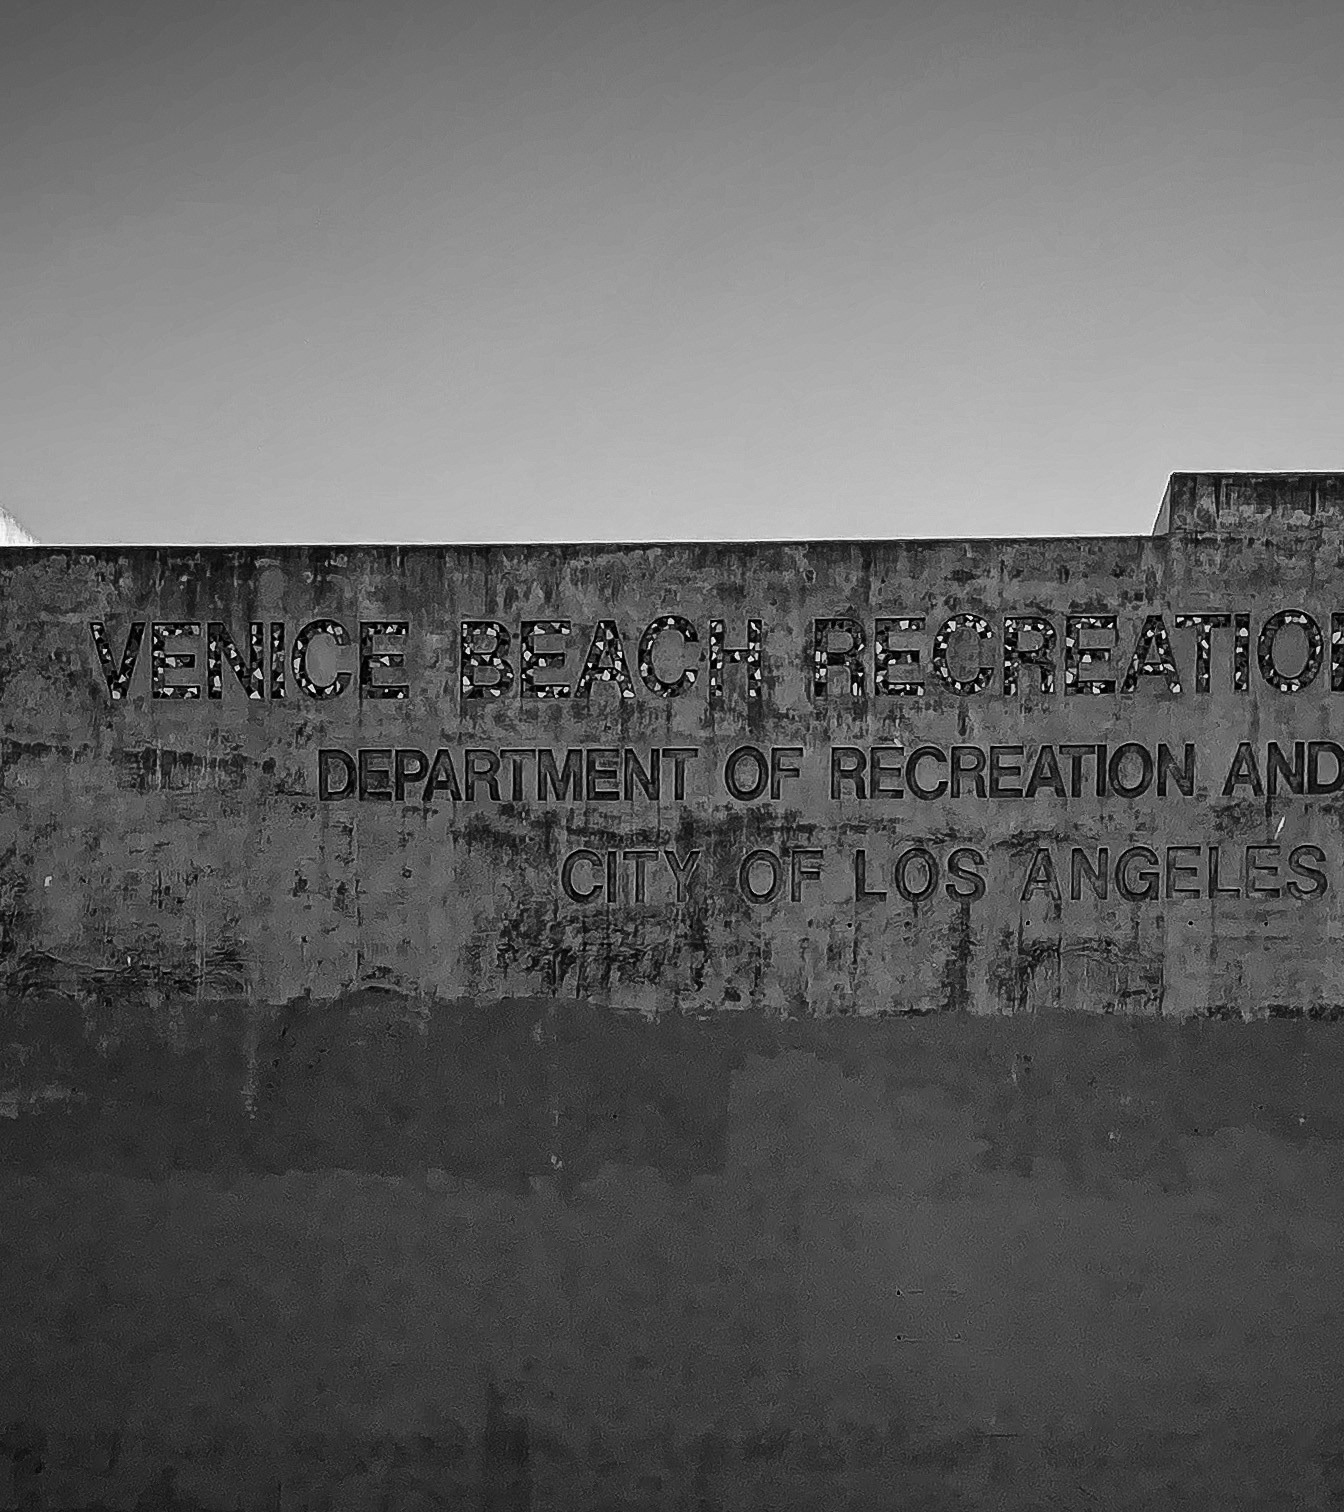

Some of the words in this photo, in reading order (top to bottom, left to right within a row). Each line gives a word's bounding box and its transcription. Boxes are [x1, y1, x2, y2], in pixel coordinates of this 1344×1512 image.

[89, 618, 411, 700] VENICE
[460, 614, 763, 700] BEACH
[317, 747, 700, 801] DEPARTMENT
[723, 745, 804, 801] OF
[829, 741, 1196, 801] RECREATION
[560, 848, 701, 904] CITY
[737, 848, 824, 904] OF
[854, 846, 988, 903] LOS
[1020, 843, 1330, 901] ANGELES
